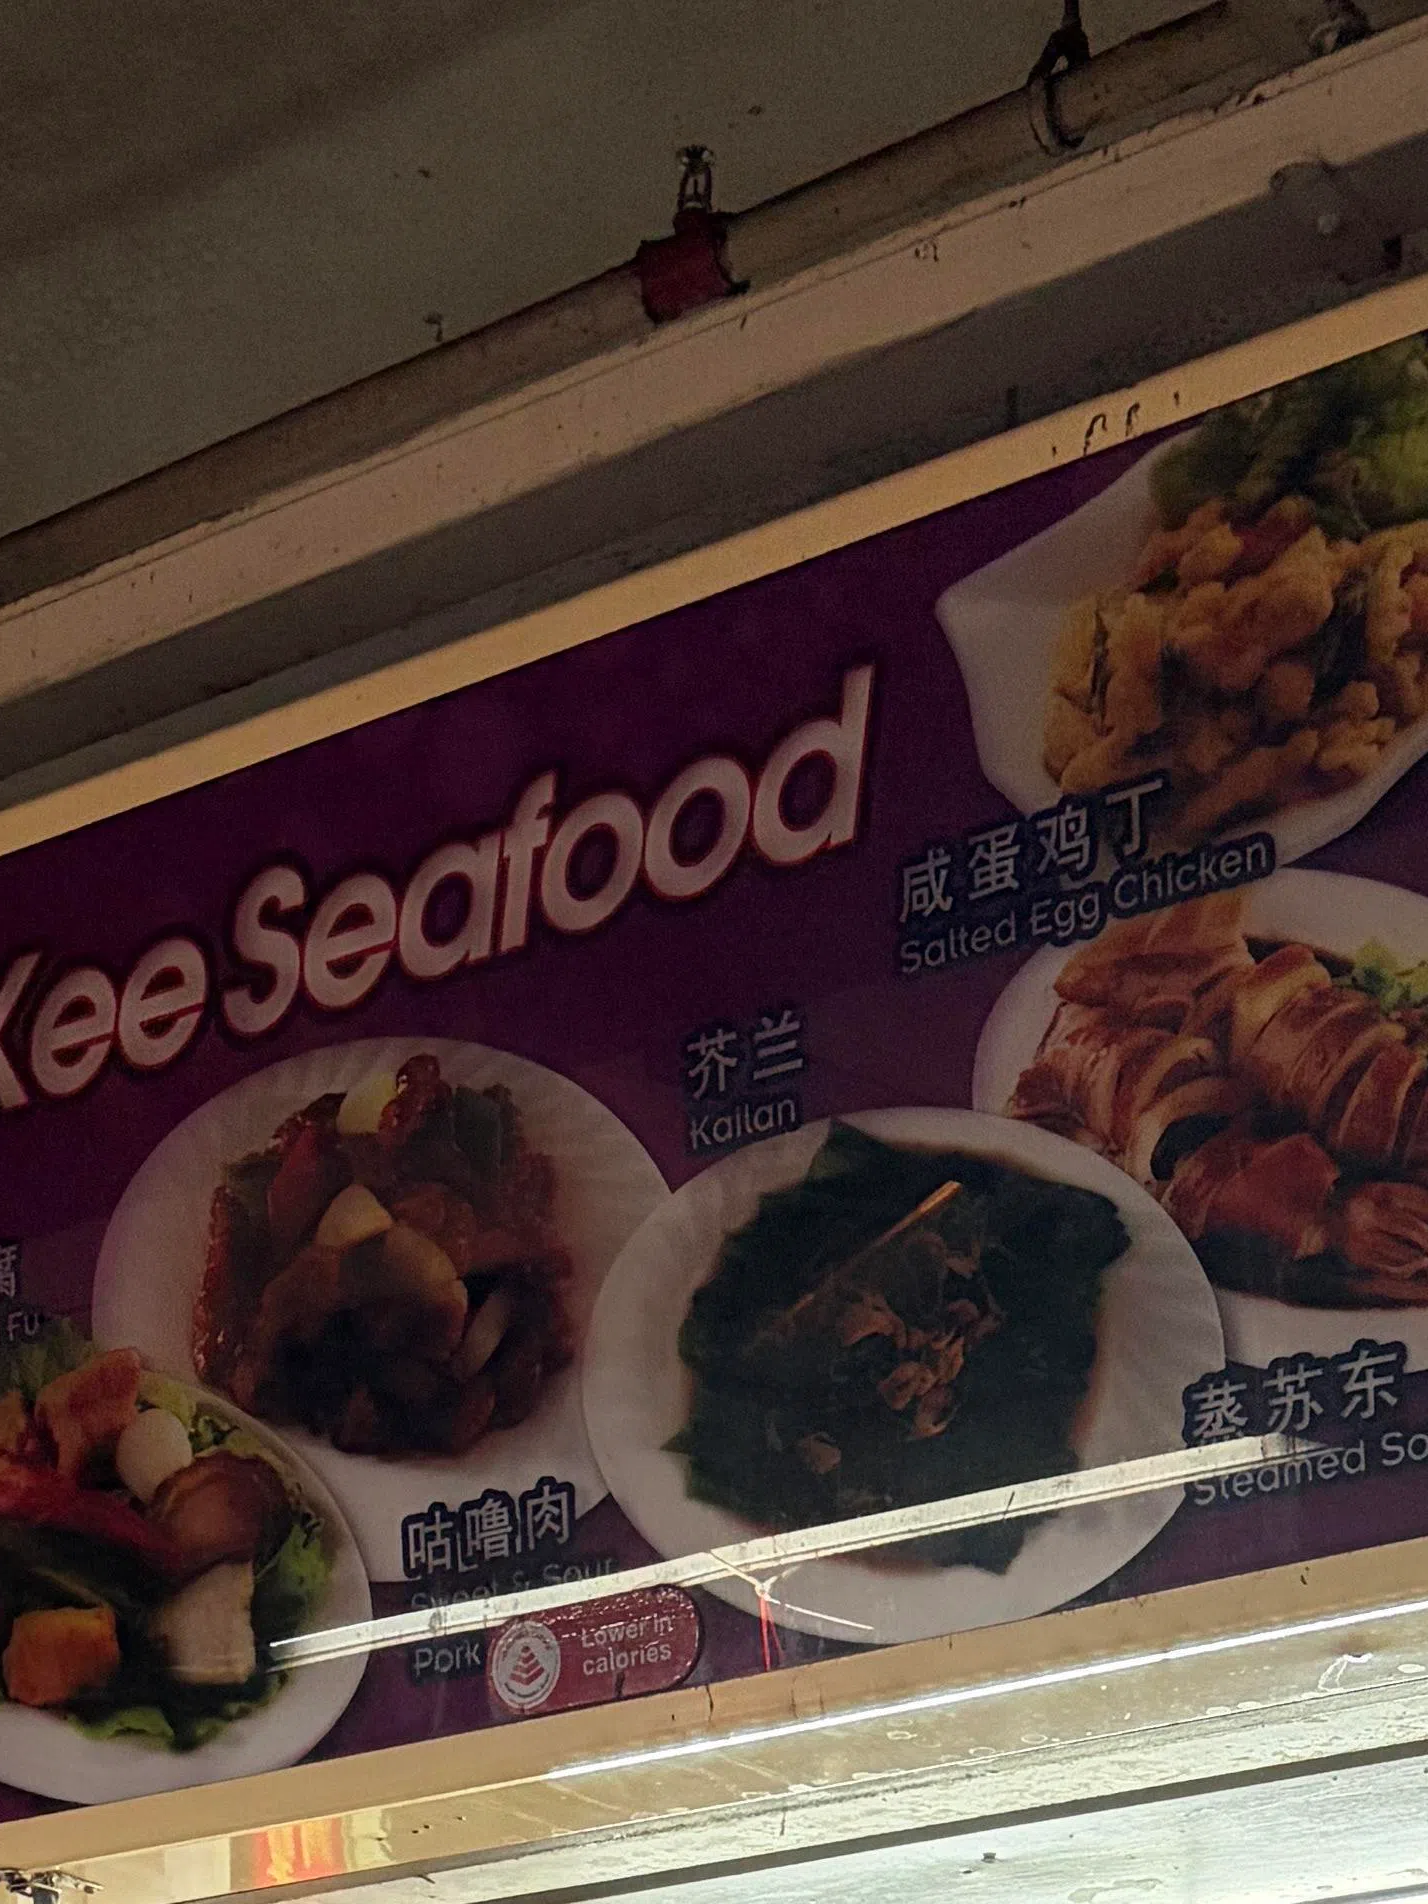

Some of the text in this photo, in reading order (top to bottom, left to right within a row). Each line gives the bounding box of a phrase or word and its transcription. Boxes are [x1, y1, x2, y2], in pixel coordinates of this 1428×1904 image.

[224, 664, 877, 1035] Seafood
[899, 778, 1164, 924] 咸蛋鸡丁
[900, 841, 1268, 974] Salted Egg Chicken
[686, 1009, 804, 1099] 芥兰
[689, 1098, 796, 1151] Kailan
[7, 1311, 40, 1341] Fu
[1192, 1349, 1398, 1446] 蒸苏东
[407, 1485, 571, 1576] 咕噜肉
[413, 1643, 481, 1678] Pork
[580, 1619, 648, 1650] Lower
[582, 1640, 673, 1676] calories
